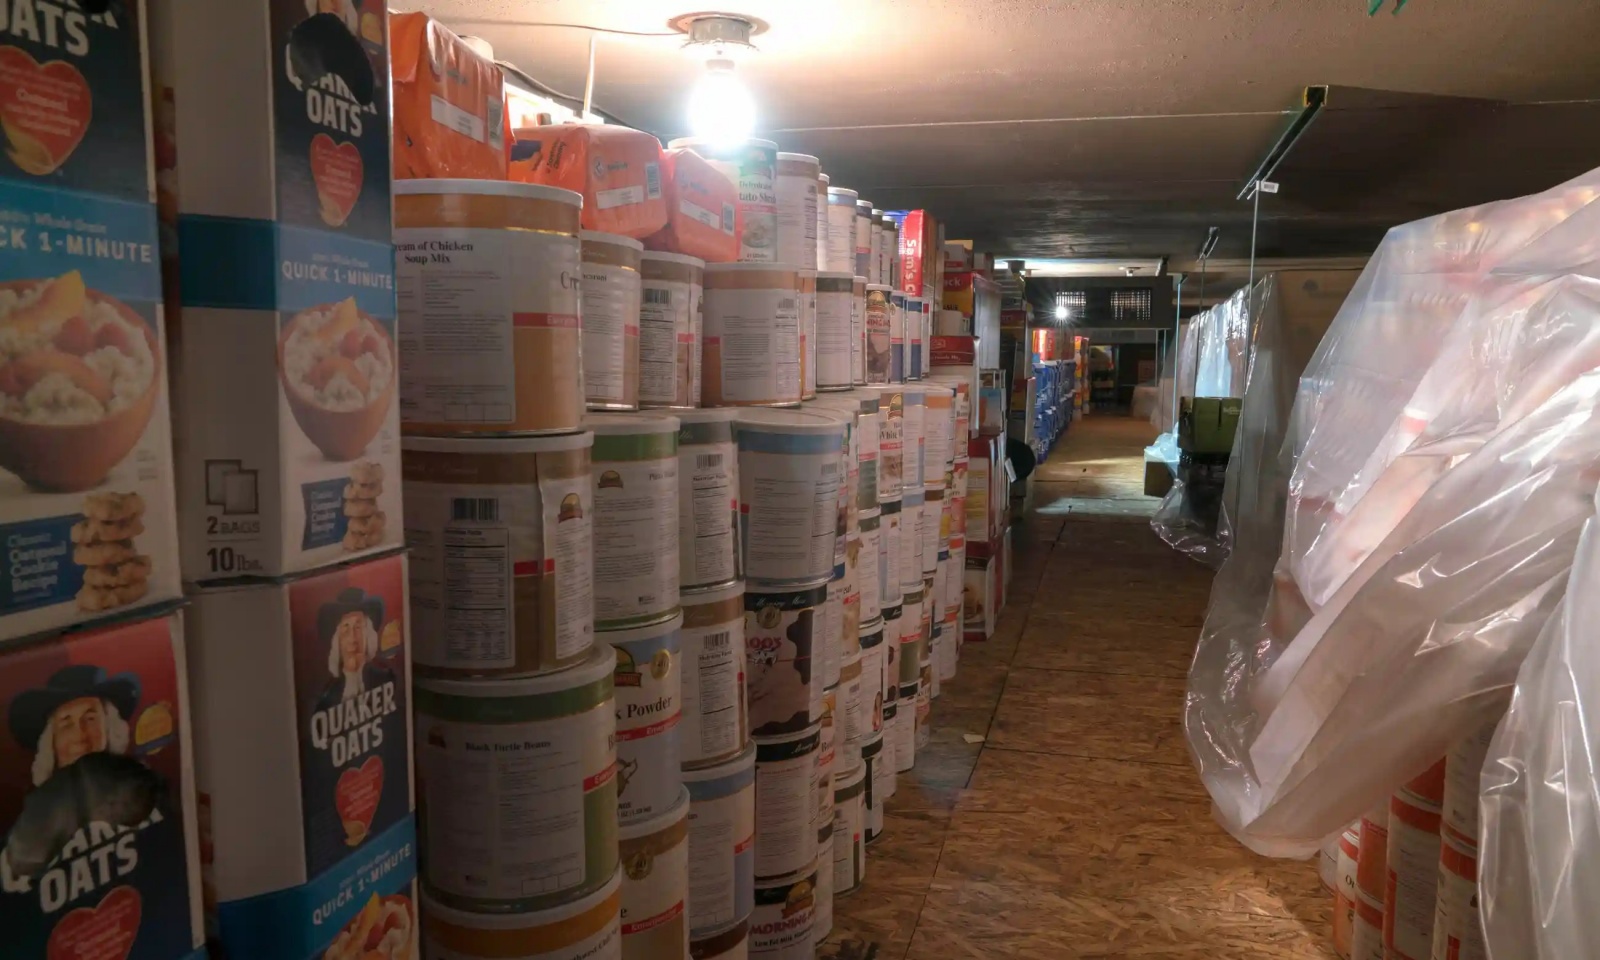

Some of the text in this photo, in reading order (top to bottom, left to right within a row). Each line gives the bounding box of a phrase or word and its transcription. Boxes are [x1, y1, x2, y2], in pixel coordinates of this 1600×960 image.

[306, 88, 363, 138] OATS
[38, 231, 153, 263] 1-MINUTE
[404, 253, 452, 266] Soup Mix
[430, 240, 474, 252] Chicken
[904, 239, 917, 281] Sam's
[282, 260, 328, 282] QUICK
[333, 268, 393, 290] 1-MINUTE
[206, 515, 261, 535] 2 BAGS
[206, 546, 236, 573] 10
[311, 681, 397, 751] QUAKER
[627, 695, 672, 719] Powder
[331, 716, 384, 768] OATS
[39, 832, 138, 913] OATS
[312, 886, 355, 926] QUICK
[357, 842, 412, 894] 1-MINUTE
